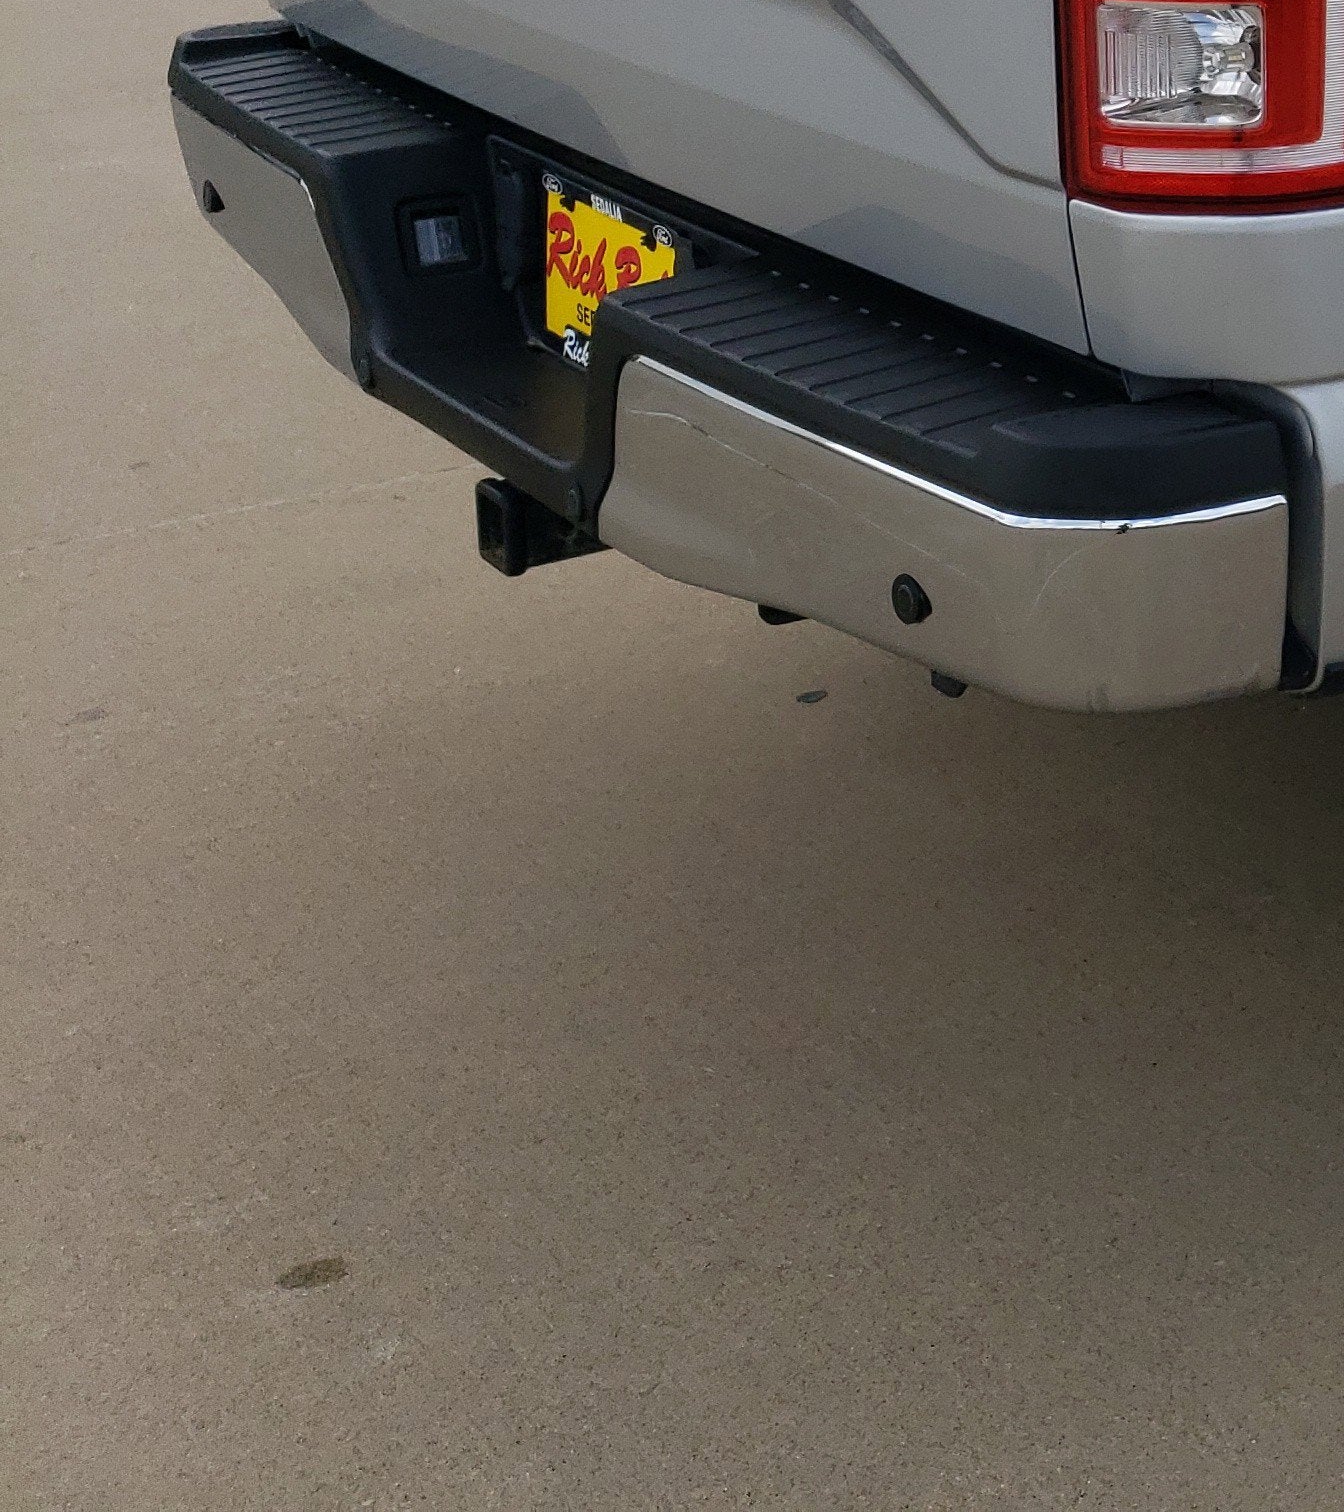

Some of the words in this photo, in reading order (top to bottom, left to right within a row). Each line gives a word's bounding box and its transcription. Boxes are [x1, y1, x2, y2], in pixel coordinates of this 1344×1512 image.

[590, 193, 623, 222] SEDALIA
[547, 211, 607, 303] Rick
[563, 328, 590, 367] Rick
